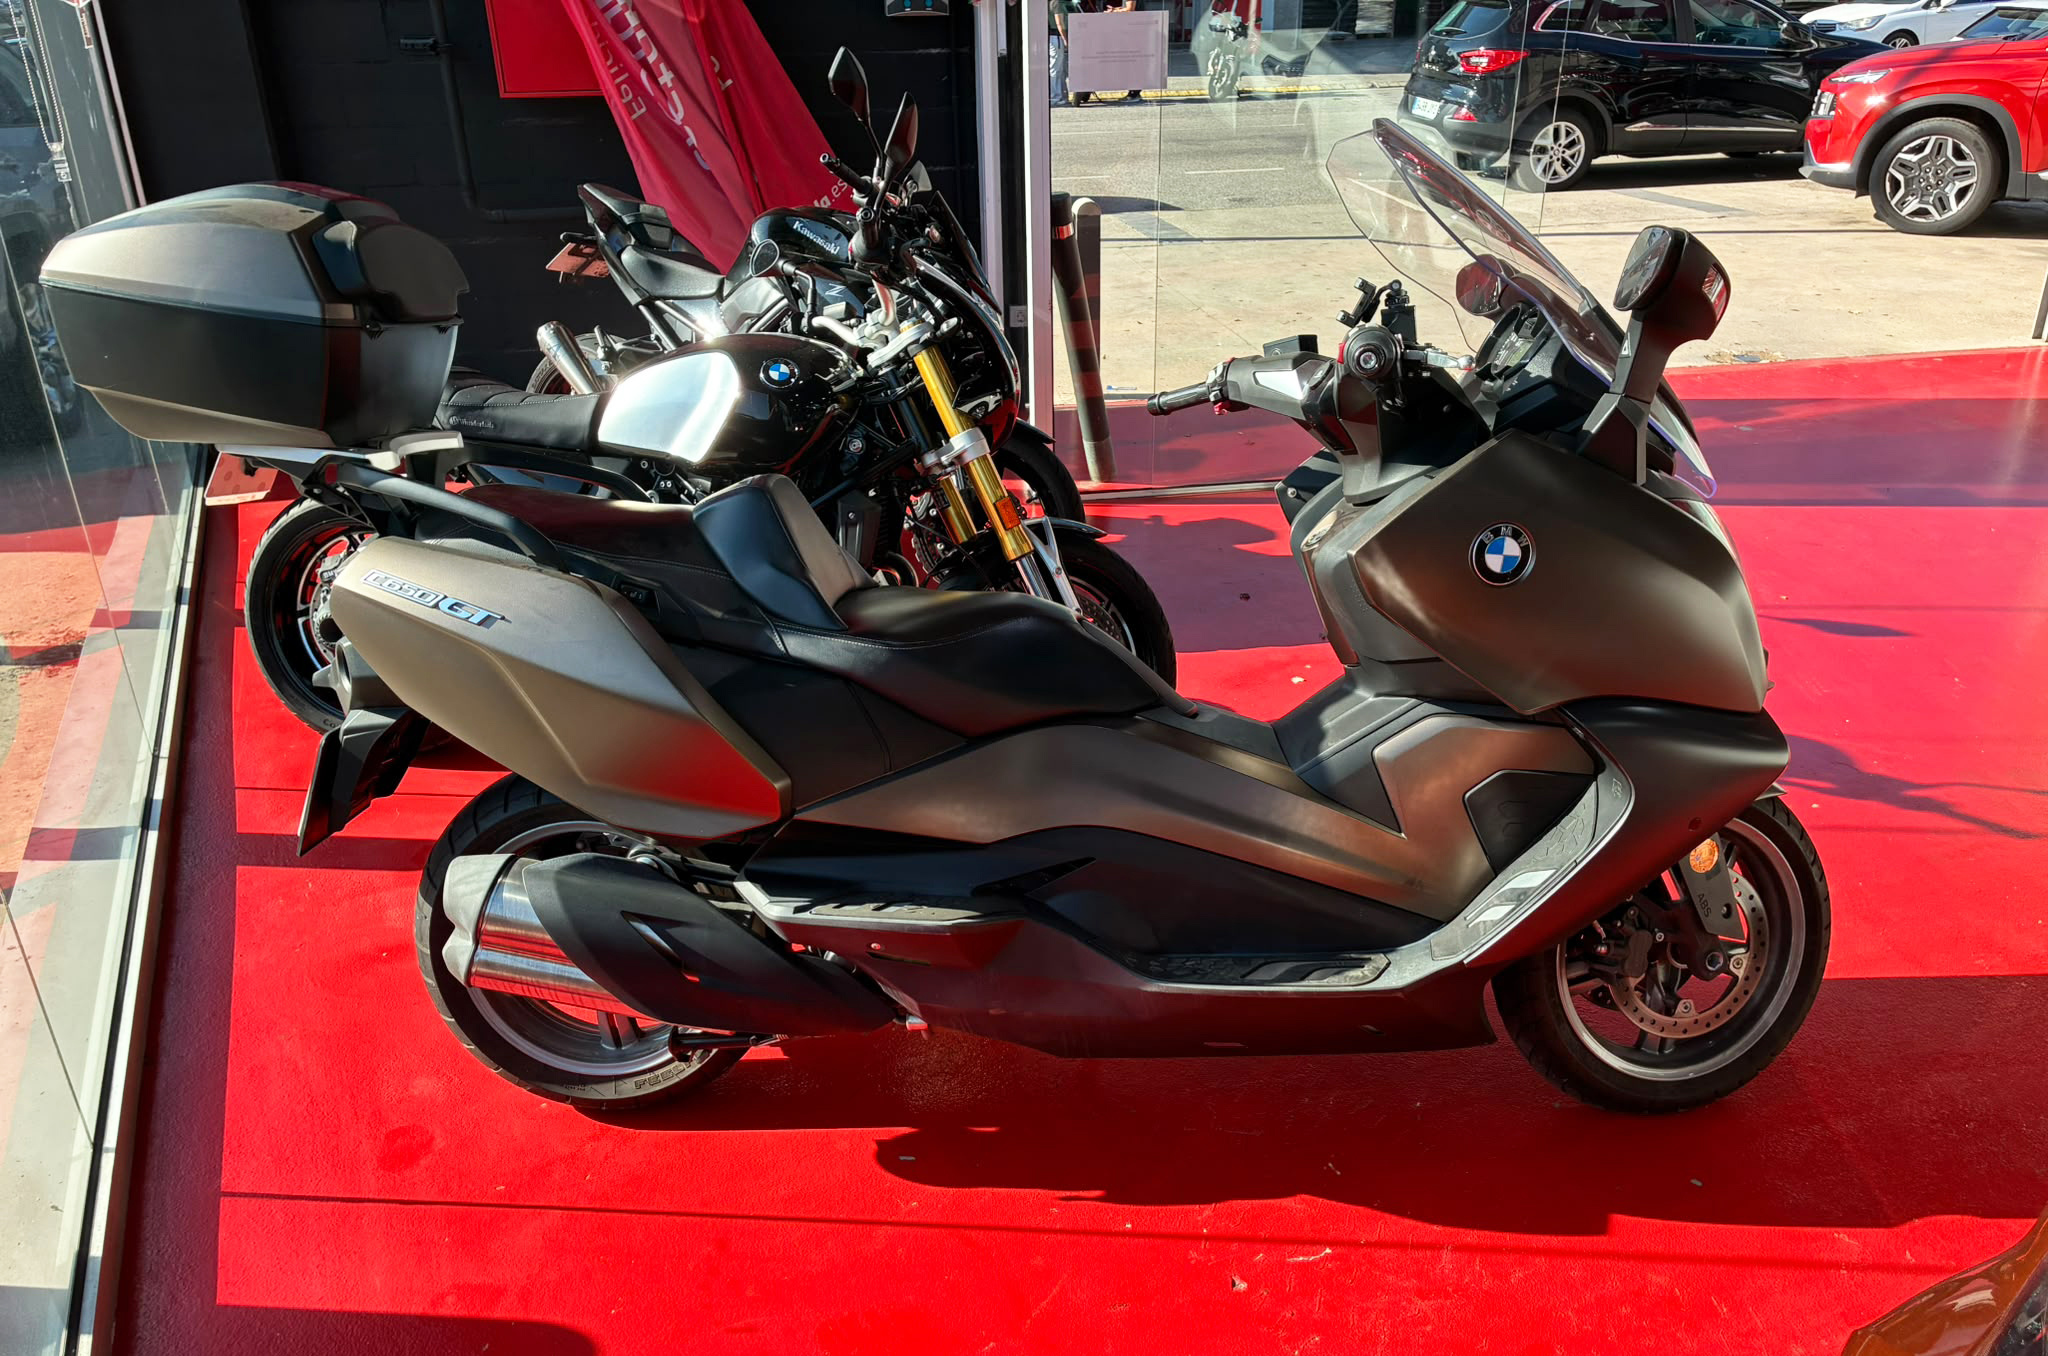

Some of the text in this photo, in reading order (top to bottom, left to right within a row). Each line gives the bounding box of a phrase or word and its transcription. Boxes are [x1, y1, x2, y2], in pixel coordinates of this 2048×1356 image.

[793, 220, 840, 255] Kawasaki
[1480, 525, 1530, 547] BMW
[1697, 892, 1712, 918] ABS
